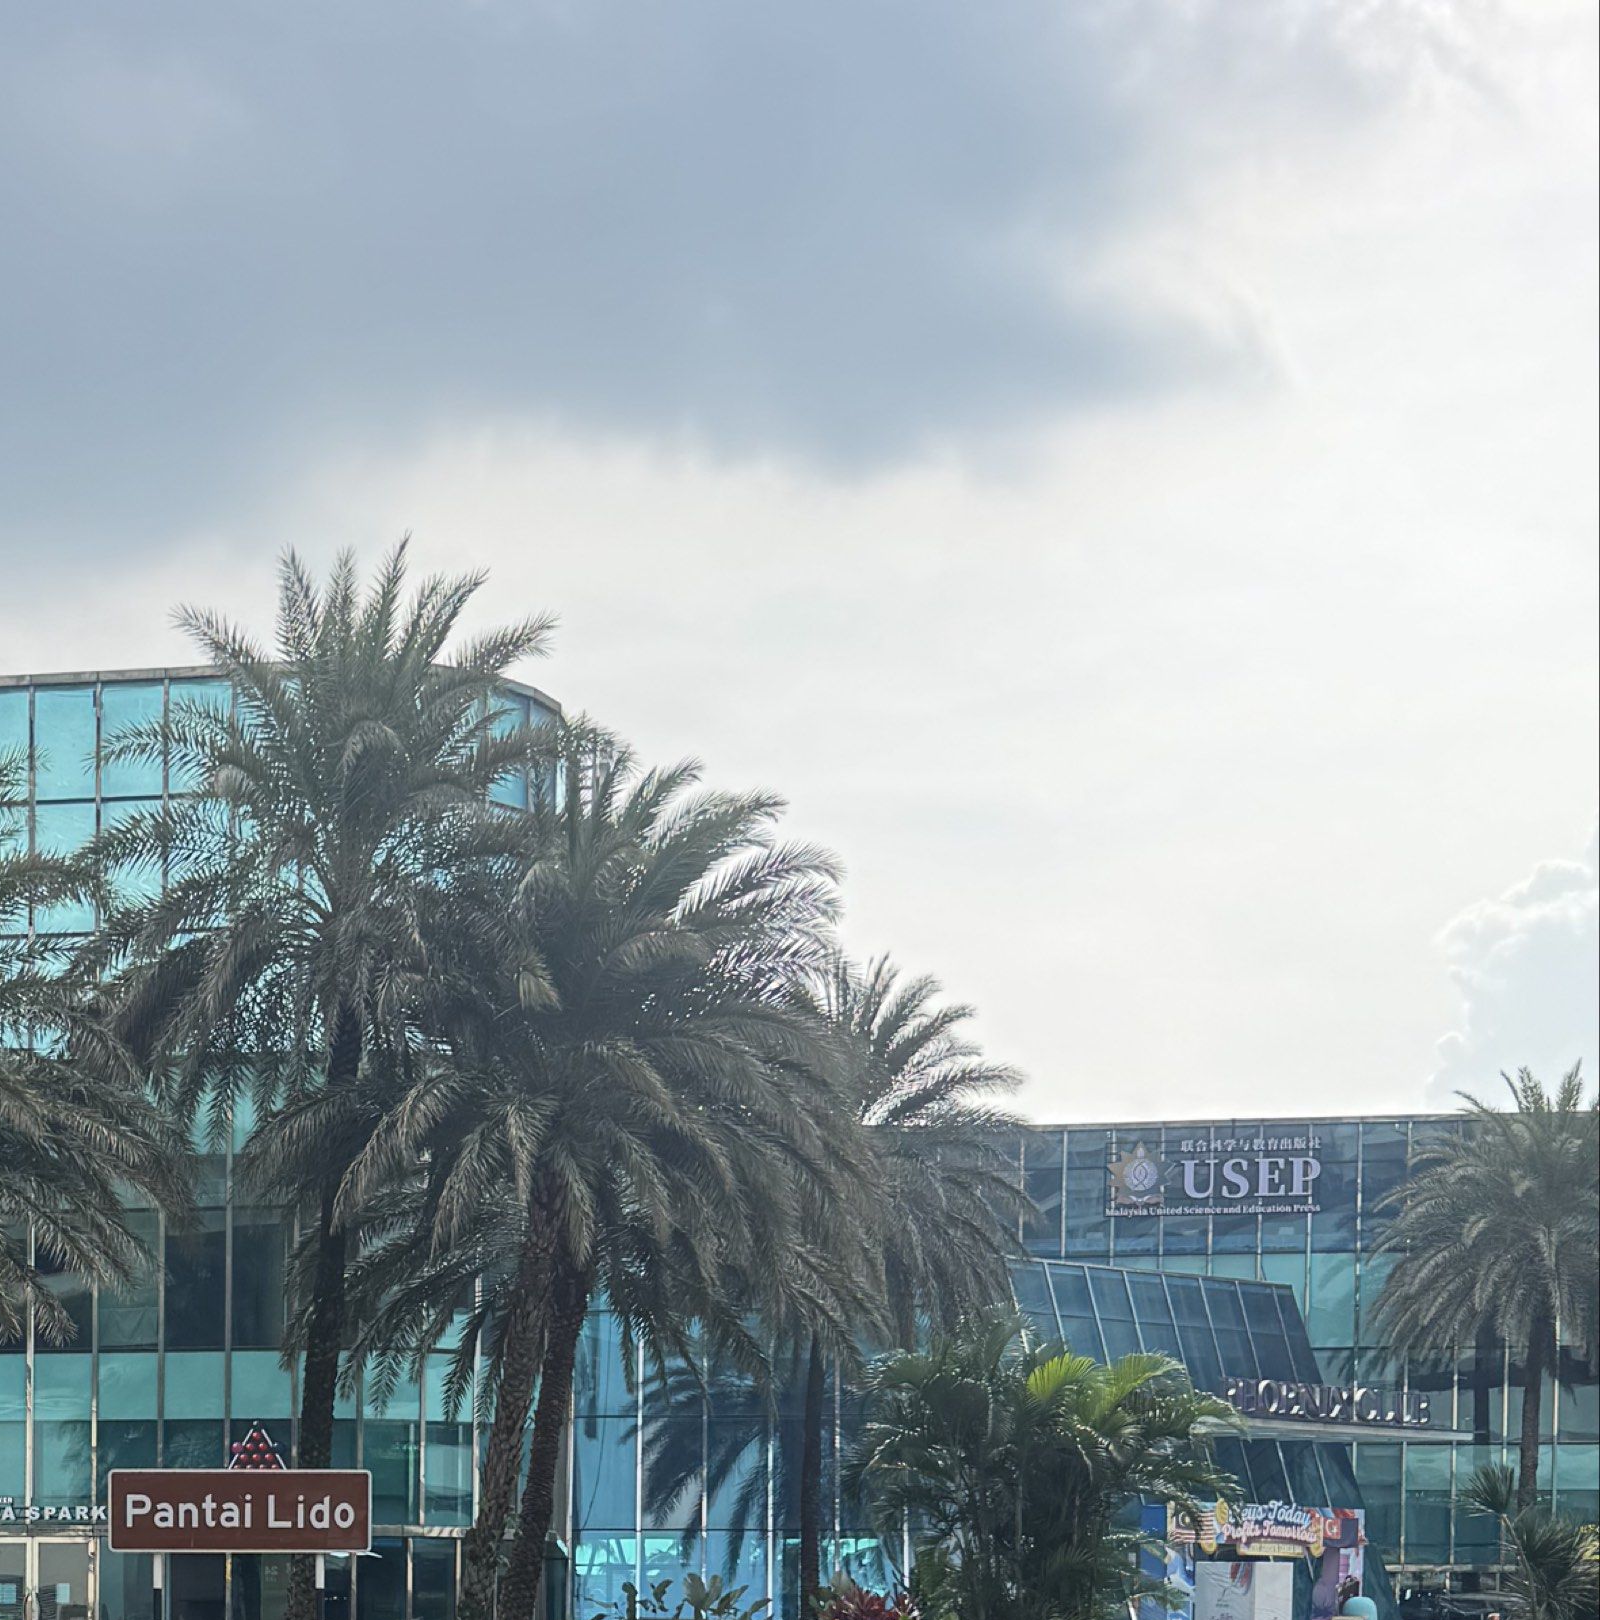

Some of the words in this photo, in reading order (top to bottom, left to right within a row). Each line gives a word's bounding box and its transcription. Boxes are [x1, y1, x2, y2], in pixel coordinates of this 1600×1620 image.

[1180, 1157, 1321, 1199] USEP
[1105, 1206, 1148, 1218] Malaysia
[1149, 1206, 1183, 1215] United
[1183, 1205, 1221, 1214] Science
[1223, 1204, 1241, 1214] and
[1243, 1204, 1291, 1213] Education
[1293, 1203, 1321, 1212] Press
[29, 1506, 108, 1520] SPARK
[126, 1494, 252, 1529] Pantai
[267, 1494, 356, 1529] Lido
[1223, 1520, 1262, 1543] Profits
[1262, 1520, 1317, 1543] Tomorrow
